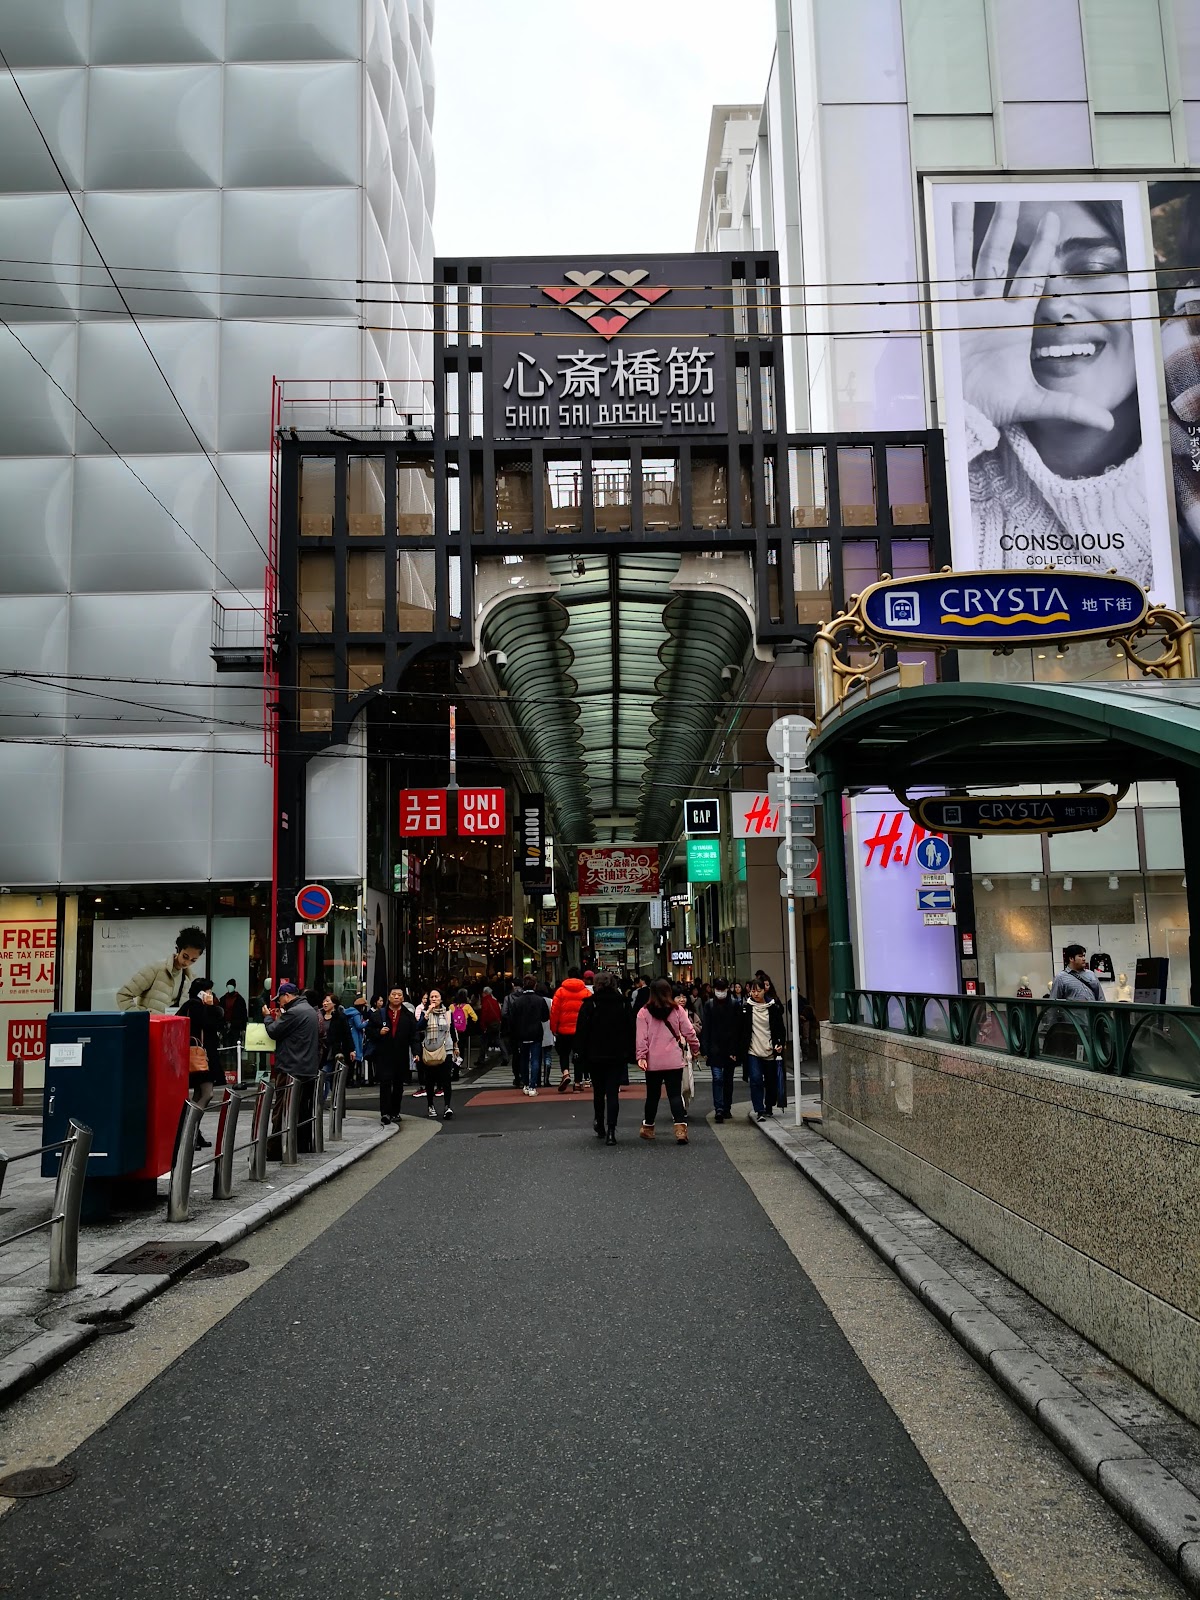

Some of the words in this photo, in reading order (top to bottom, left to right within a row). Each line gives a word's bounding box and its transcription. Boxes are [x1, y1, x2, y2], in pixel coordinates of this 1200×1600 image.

[503, 346, 716, 398] 心斎橋筋
[505, 405, 550, 427] SHIN
[558, 404, 590, 427] SAI
[999, 533, 1125, 551] CONSCIOUS
[1026, 555, 1102, 566] COLLECTION
[939, 588, 1069, 613] CRYSTA
[1081, 597, 1133, 612] 地下街
[463, 794, 497, 811] UNI
[978, 803, 1054, 818] CRYSTA
[1064, 806, 1098, 817] 地下街
[463, 813, 500, 832] QLO
[693, 810, 711, 824] GAP
[587, 868, 641, 882] 大抽選会
[3, 928, 57, 949] FREE
[17, 951, 32, 959] TAX
[34, 951, 55, 959] FREE
[12, 1025, 42, 1040] UNI
[11, 1042, 44, 1058] QLO
